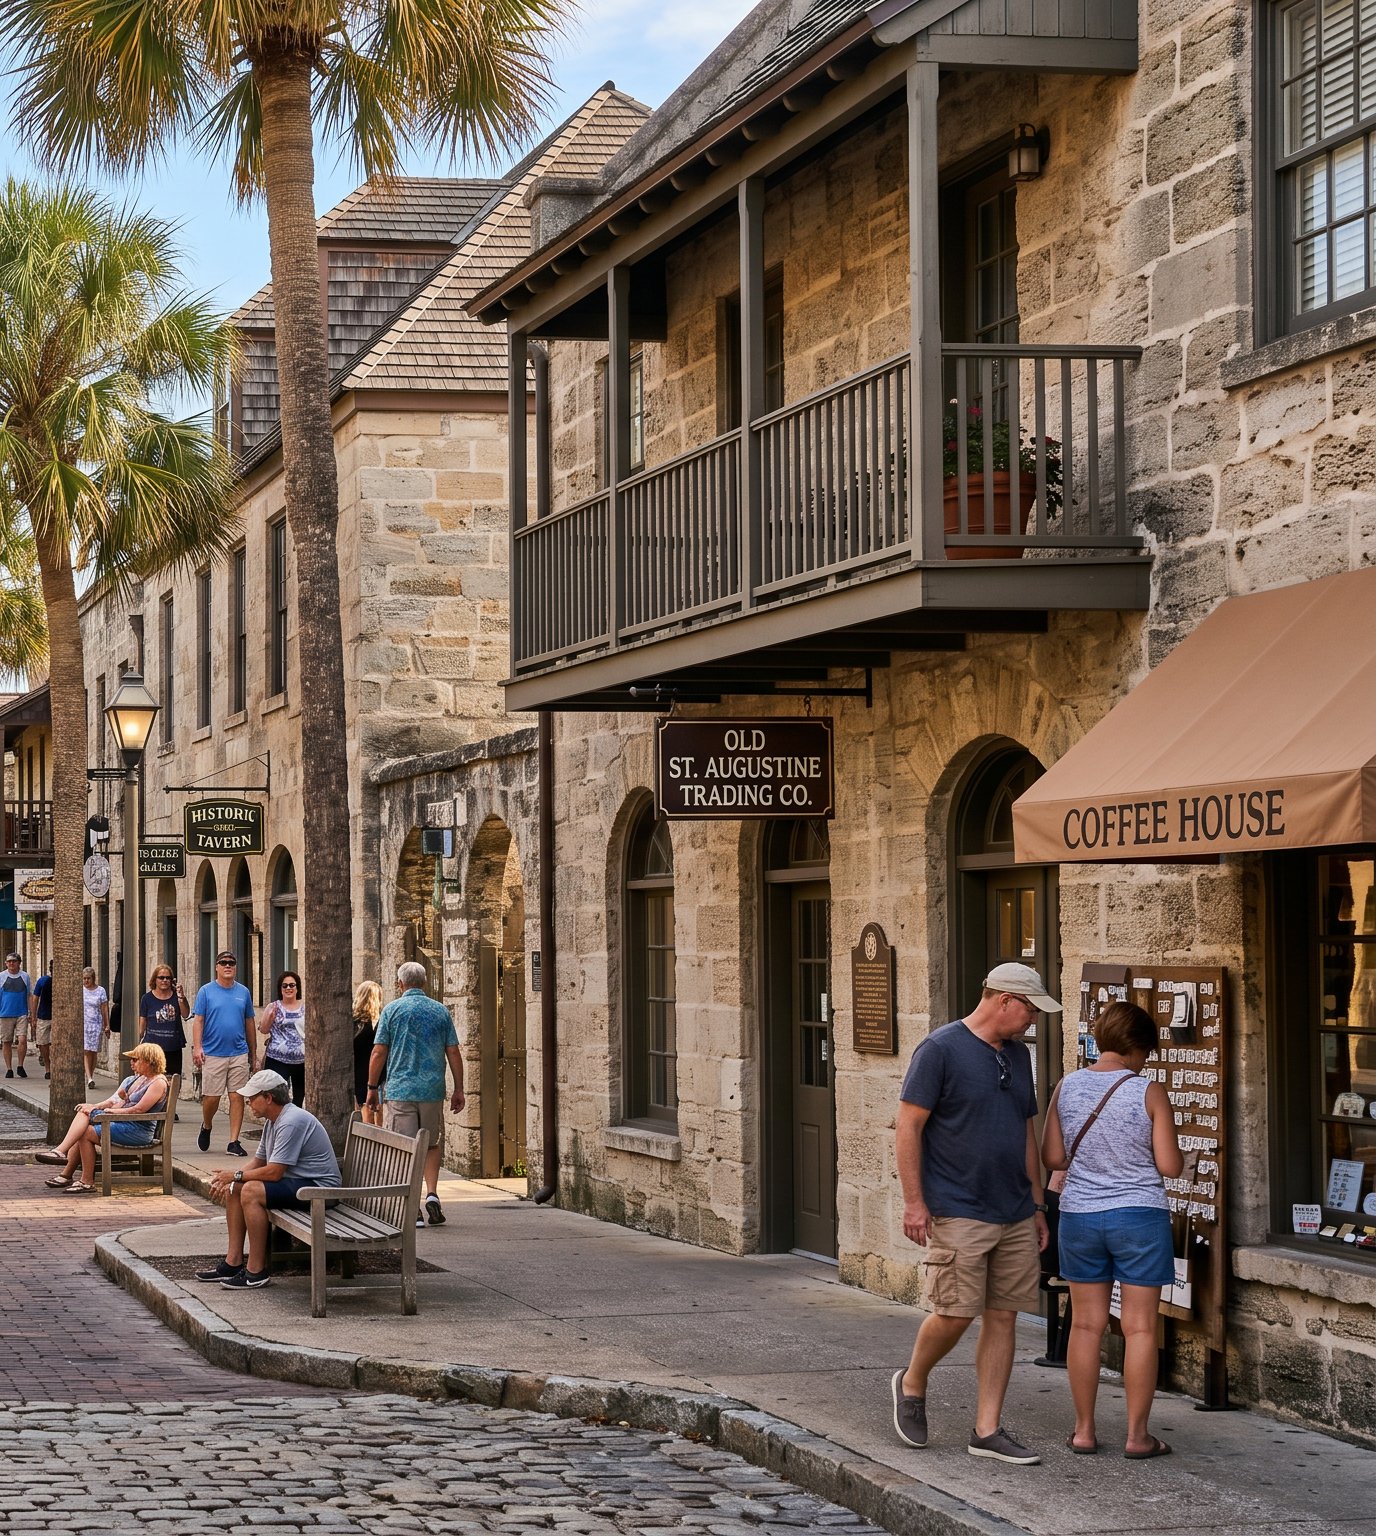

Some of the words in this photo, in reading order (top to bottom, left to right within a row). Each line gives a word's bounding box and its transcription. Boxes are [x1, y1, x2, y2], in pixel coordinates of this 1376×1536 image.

[724, 729, 766, 751] OLD
[669, 756, 698, 779] ST.
[704, 756, 822, 779] AUGUSTINE
[680, 784, 773, 806] TRADING
[779, 784, 813, 806] CO.
[191, 807, 256, 824] HISTORIC
[1063, 800, 1170, 850] COFFEE
[1178, 789, 1286, 843] HOUSE
[196, 833, 252, 849] TAVERN
